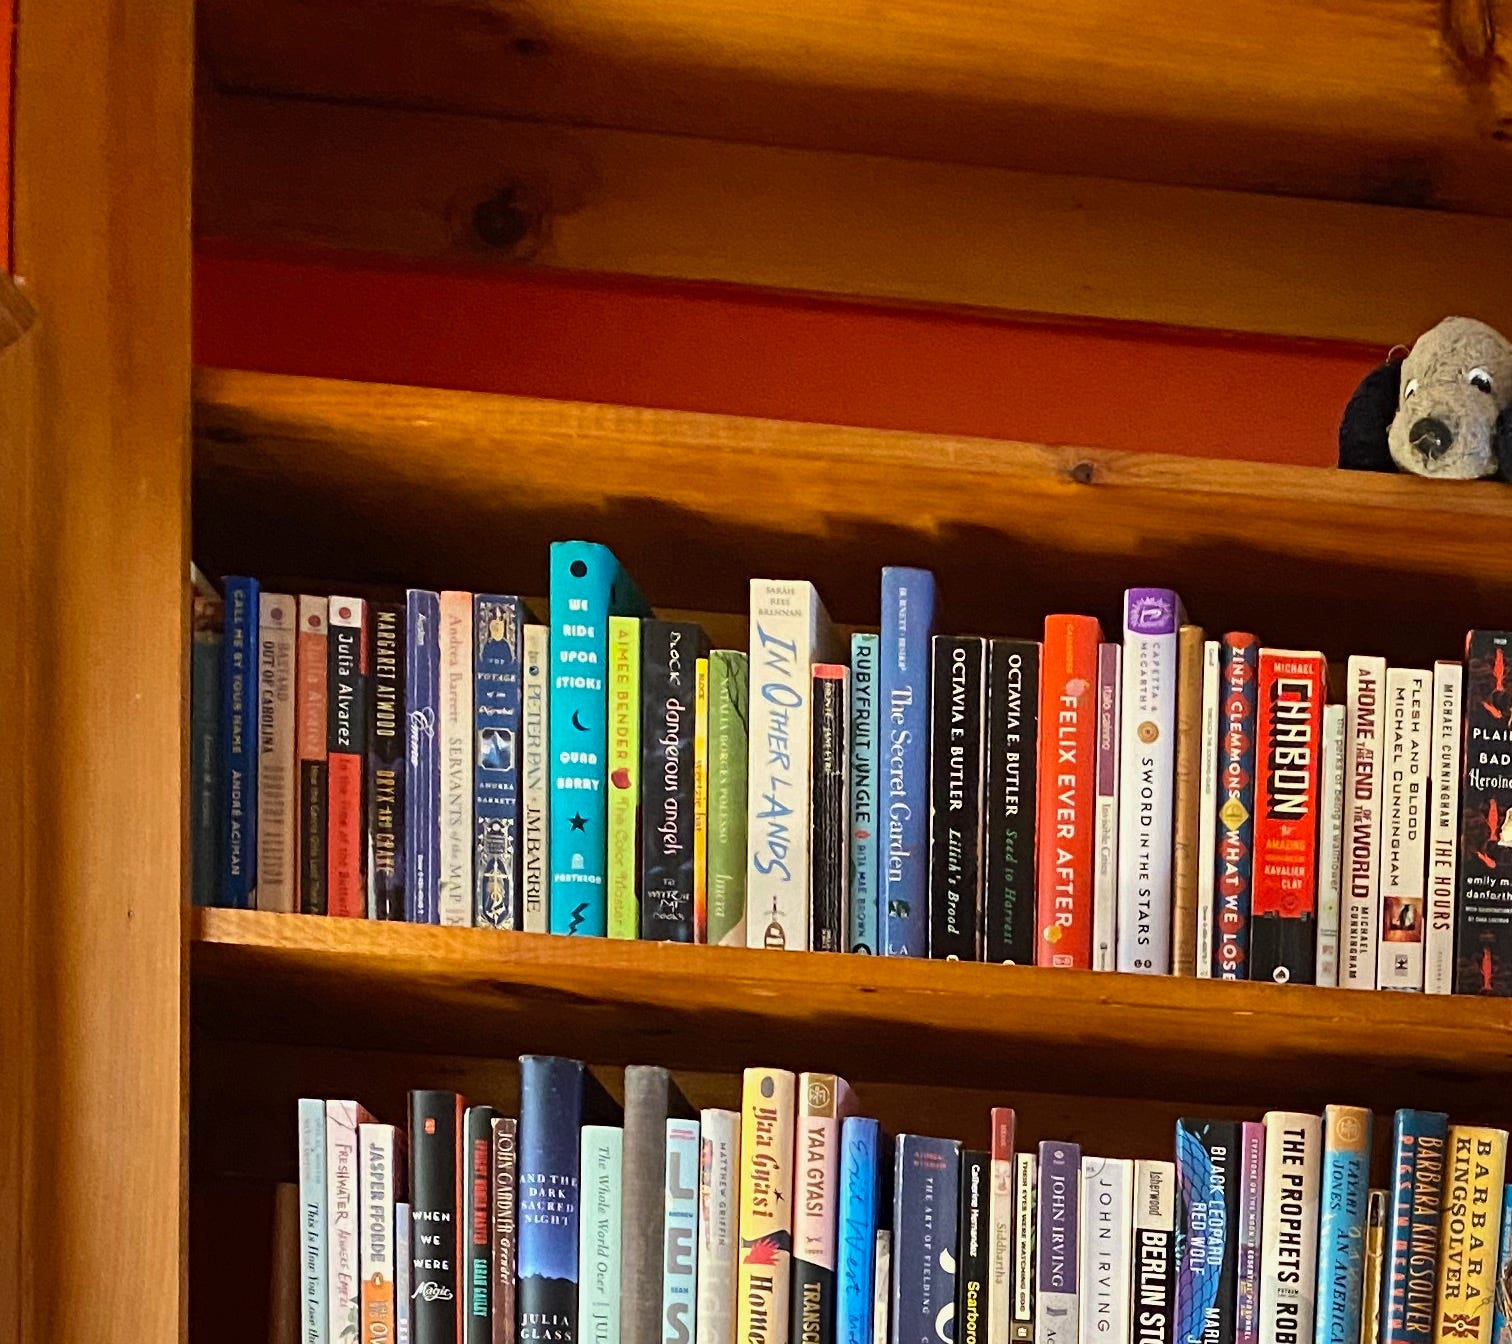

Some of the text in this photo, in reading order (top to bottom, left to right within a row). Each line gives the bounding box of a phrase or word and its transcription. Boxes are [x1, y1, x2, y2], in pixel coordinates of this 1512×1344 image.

[337, 633, 354, 746] Julia Alvarez
[754, 622, 803, 881] IN OTHER LANDS
[855, 646, 871, 823] RUBYFRUIT JUNGLE
[949, 649, 965, 811] OCTAVIA E. BUTLER
[1273, 678, 1312, 813] CHABON
[658, 698, 686, 855] dangerous angels
[886, 686, 913, 882] The Secret Garden
[1055, 696, 1078, 927] FELIX EVER AFTER
[1137, 757, 1154, 946] SWORD IN THE STARS
[1432, 840, 1452, 931] THE HOURS
[1050, 1175, 1066, 1287] JOHN IRVING
[1140, 1231, 1167, 1307] BERLIN
[1278, 1128, 1305, 1283] THE PROPHETS
[1445, 1138, 1471, 1300] KINGSOLVER
[1465, 1139, 1493, 1301] BARBARA
